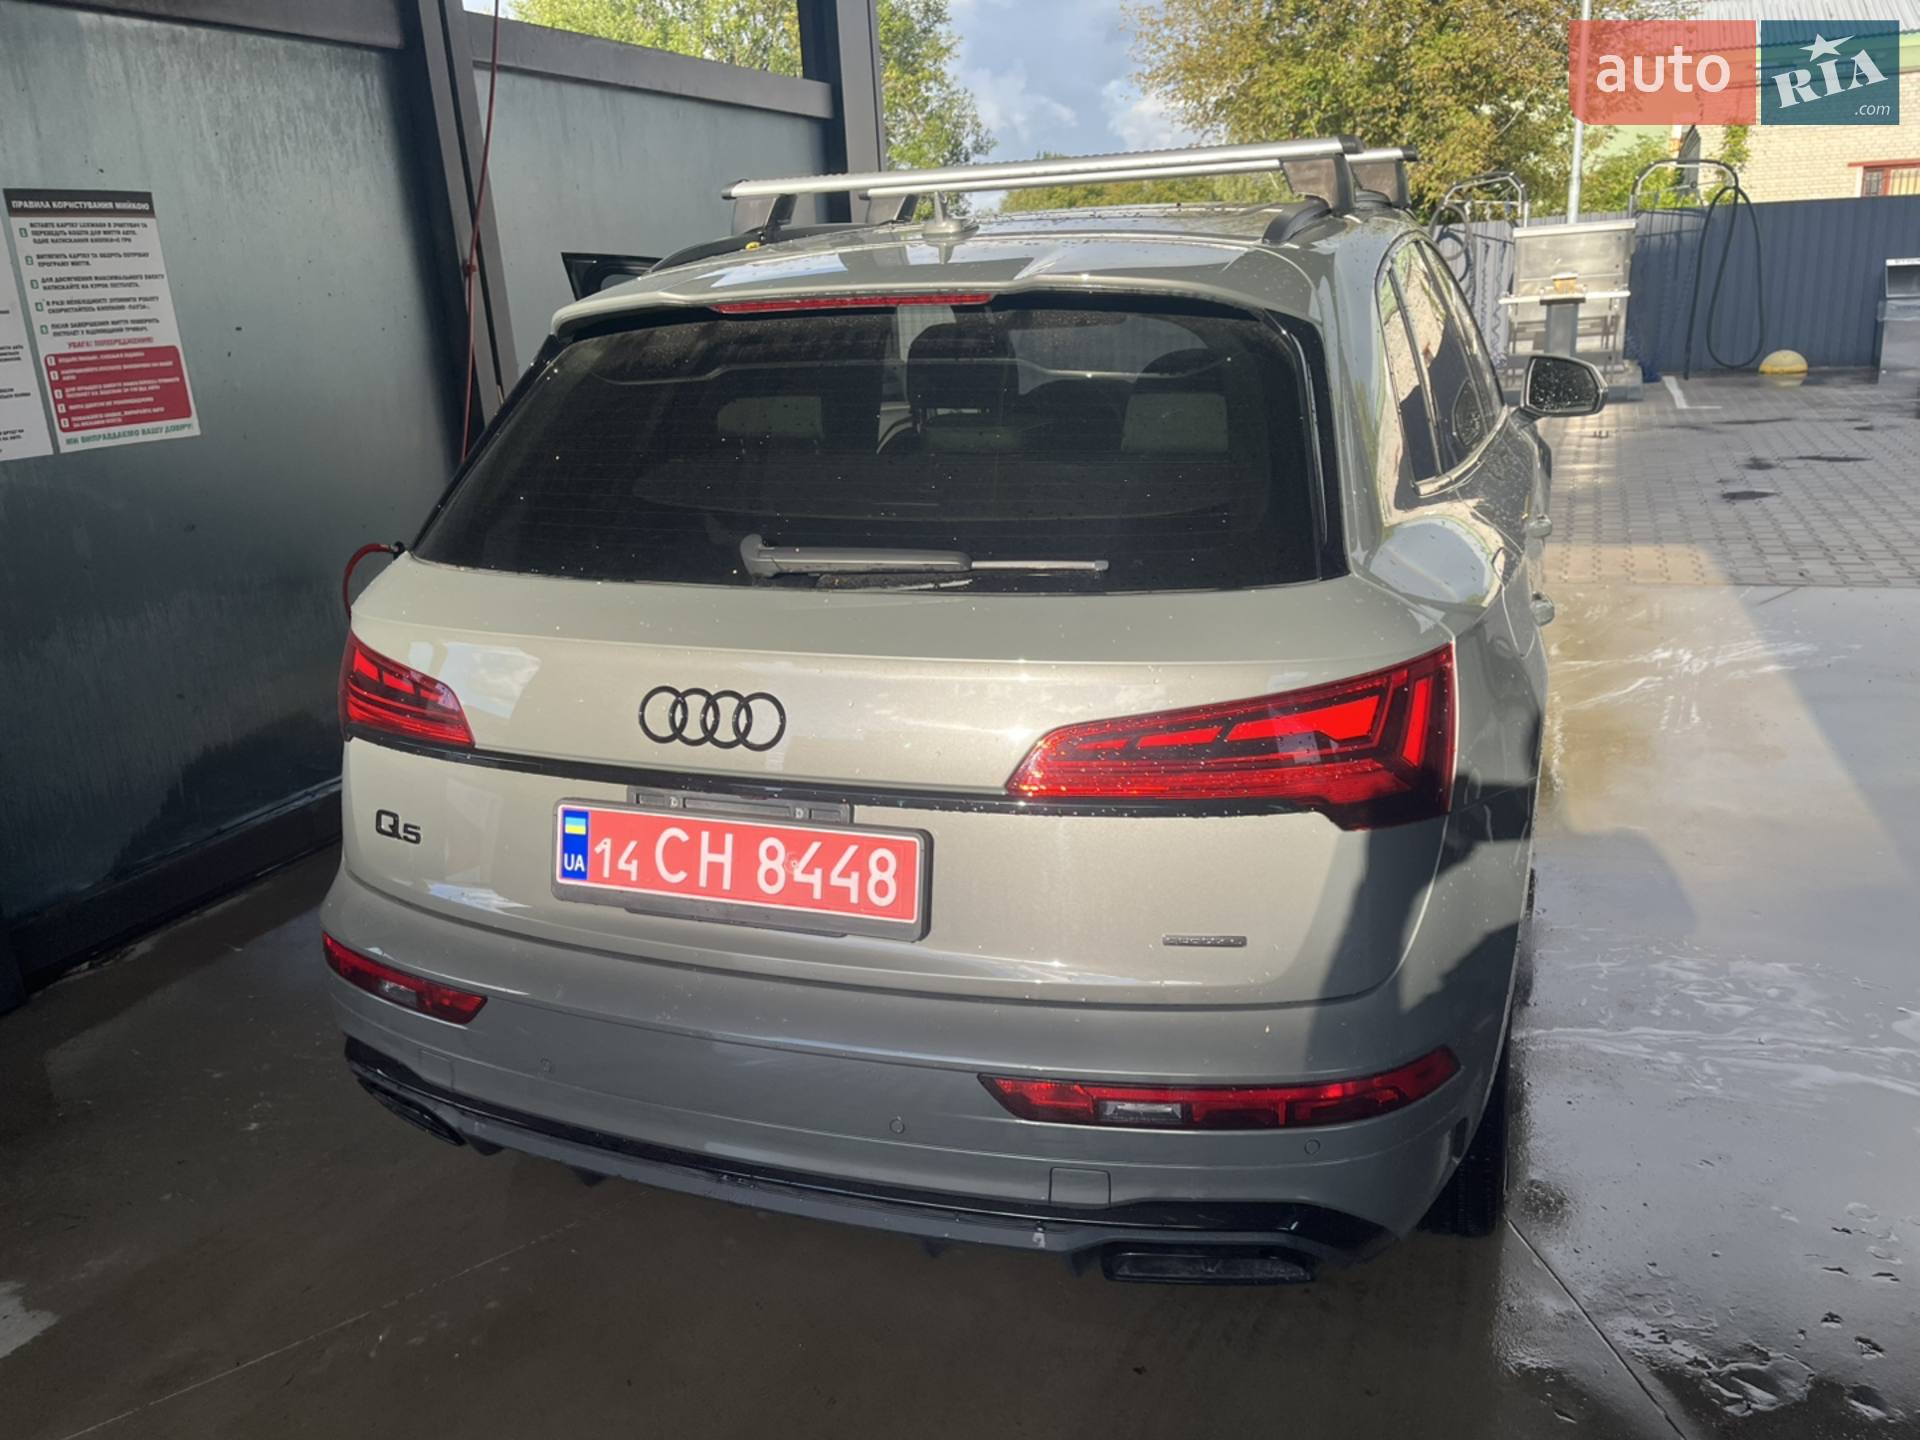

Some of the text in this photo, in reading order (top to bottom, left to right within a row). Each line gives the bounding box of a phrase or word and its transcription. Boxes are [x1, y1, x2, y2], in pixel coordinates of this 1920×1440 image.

[11, 200, 150, 209] ПРАВИЛА КОРИСТУВАННЯ МИЙКОЮ
[375, 808, 422, 845] Q5
[563, 853, 586, 873] UA
[594, 826, 898, 908] 14 CH 8448
